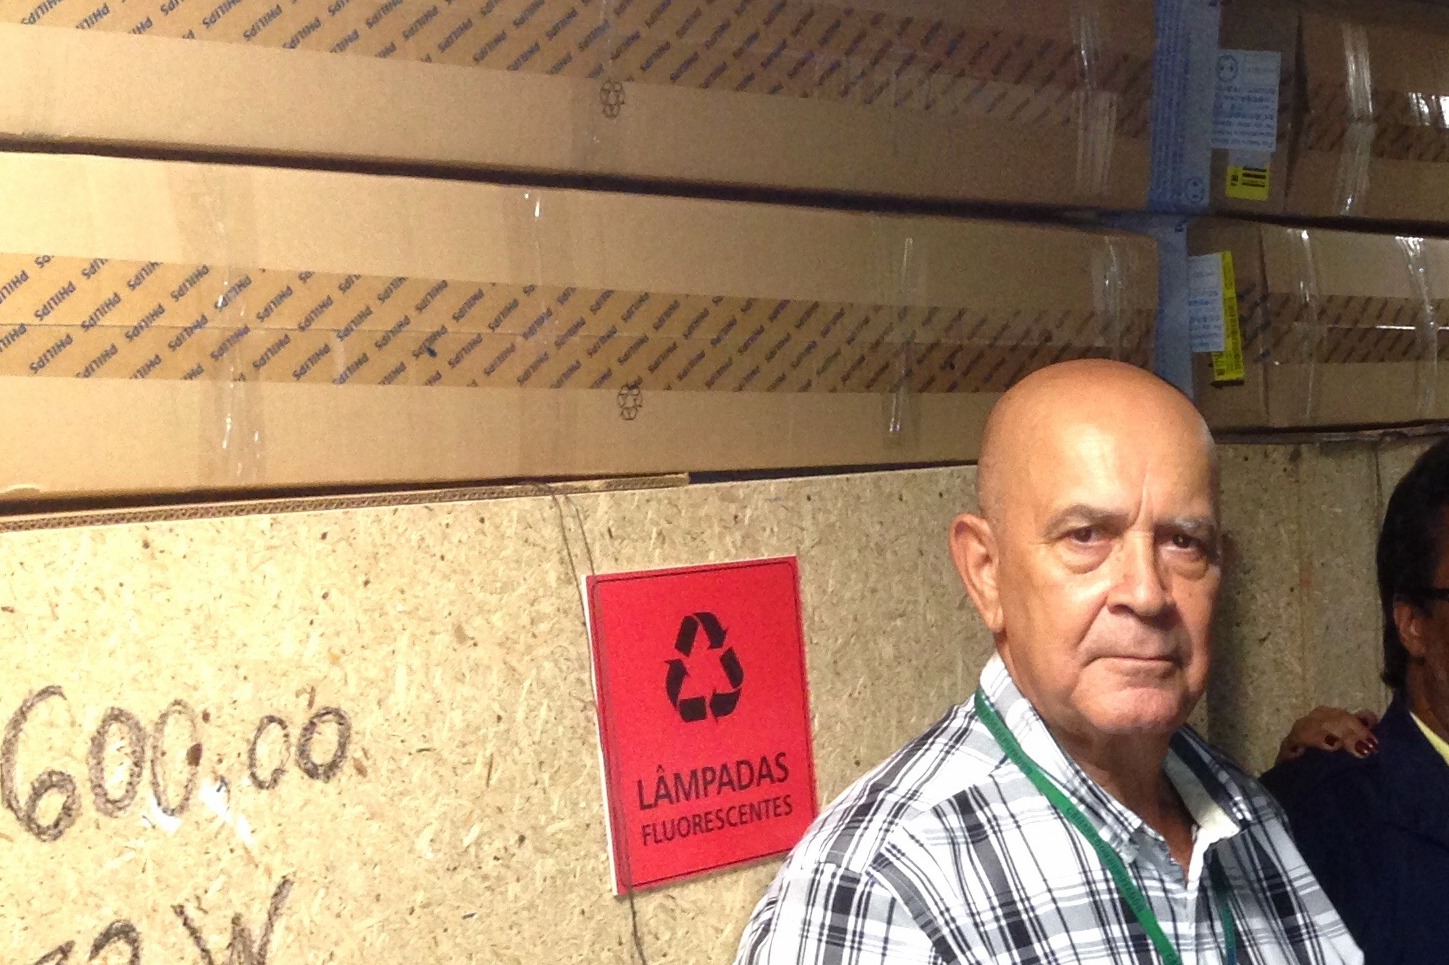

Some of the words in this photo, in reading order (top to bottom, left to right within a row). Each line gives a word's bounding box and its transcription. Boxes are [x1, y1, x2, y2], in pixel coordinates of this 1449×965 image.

[34, 281, 77, 322] PHILIPS
[170, 264, 210, 302] PHILIPS
[80, 291, 122, 332] PHILIPS
[124, 303, 166, 343] PHILIPS
[29, 333, 74, 374] PHILIPS
[636, 751, 790, 811] LÂMPADAS
[641, 793, 794, 847] FLUORESCENTES
